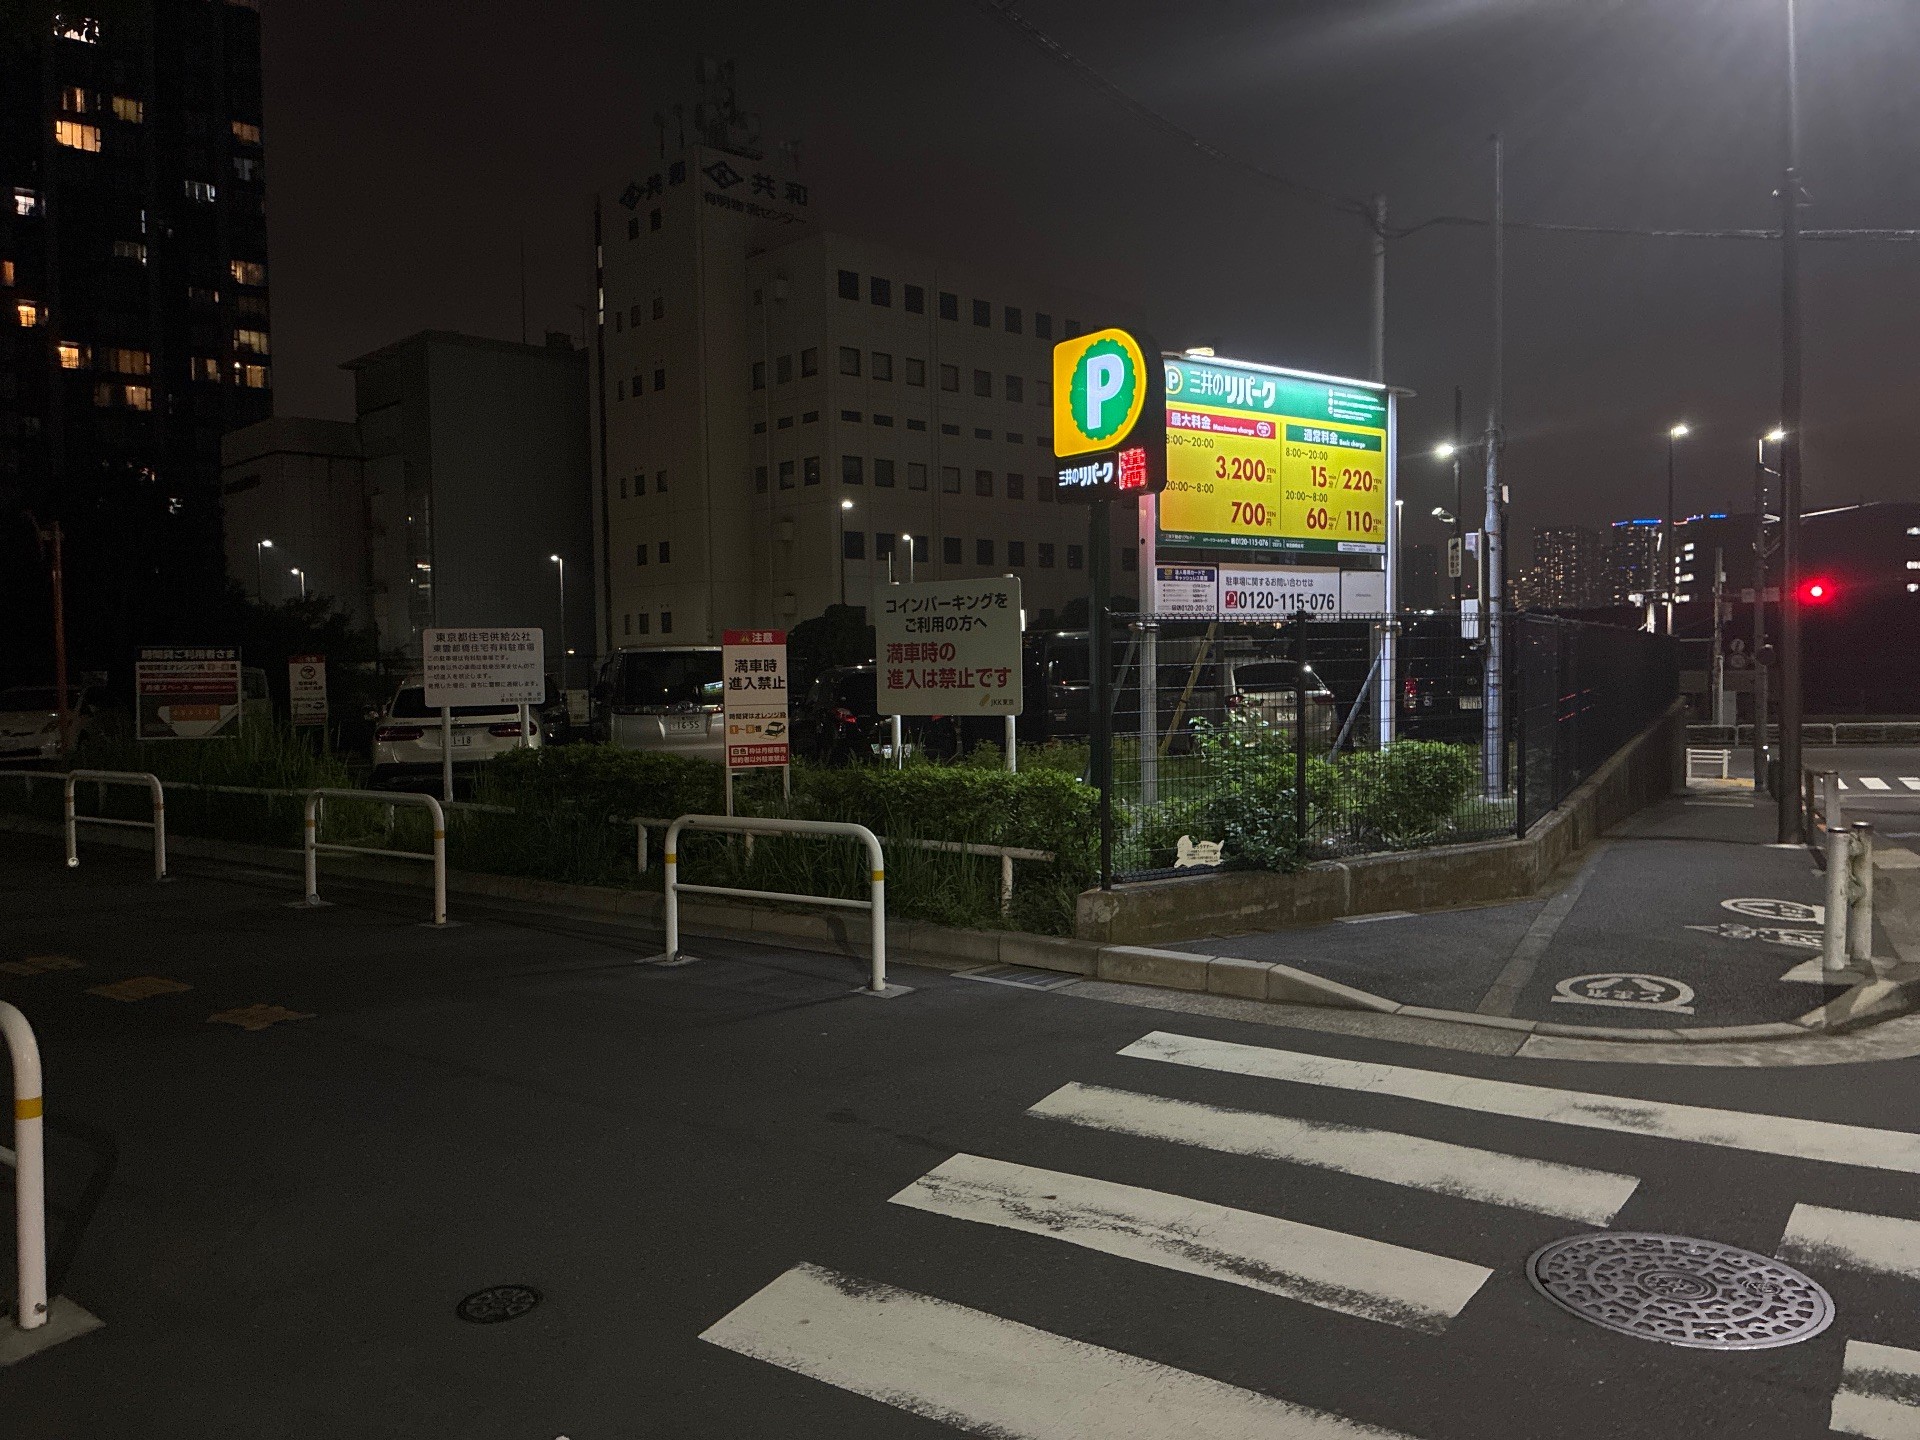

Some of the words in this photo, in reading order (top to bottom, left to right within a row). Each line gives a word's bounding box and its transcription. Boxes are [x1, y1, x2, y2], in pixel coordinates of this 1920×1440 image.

[1087, 353, 1125, 430] P
[1190, 370, 1276, 408] 三井のリパーク
[1171, 412, 1211, 430] 最大料金
[1303, 428, 1338, 445] 通常料金
[1058, 462, 1113, 486] 三井のリパーク
[1216, 455, 1266, 482] 3,200
[1311, 466, 1327, 488] 15
[1342, 468, 1373, 492] 220
[1232, 502, 1266, 526] 700
[1306, 507, 1328, 530] 60
[1346, 510, 1373, 533] 110
[1239, 591, 1335, 610] 0120-115-076
[905, 615, 988, 633] ご利用の方へ
[436, 632, 531, 642] 東京都住宅供給公社
[752, 632, 773, 643] 注意
[886, 642, 956, 663] 満車時の
[734, 659, 777, 673] 満車時
[729, 676, 786, 690] 進入禁止
[887, 667, 1012, 689] 進入は禁止です
